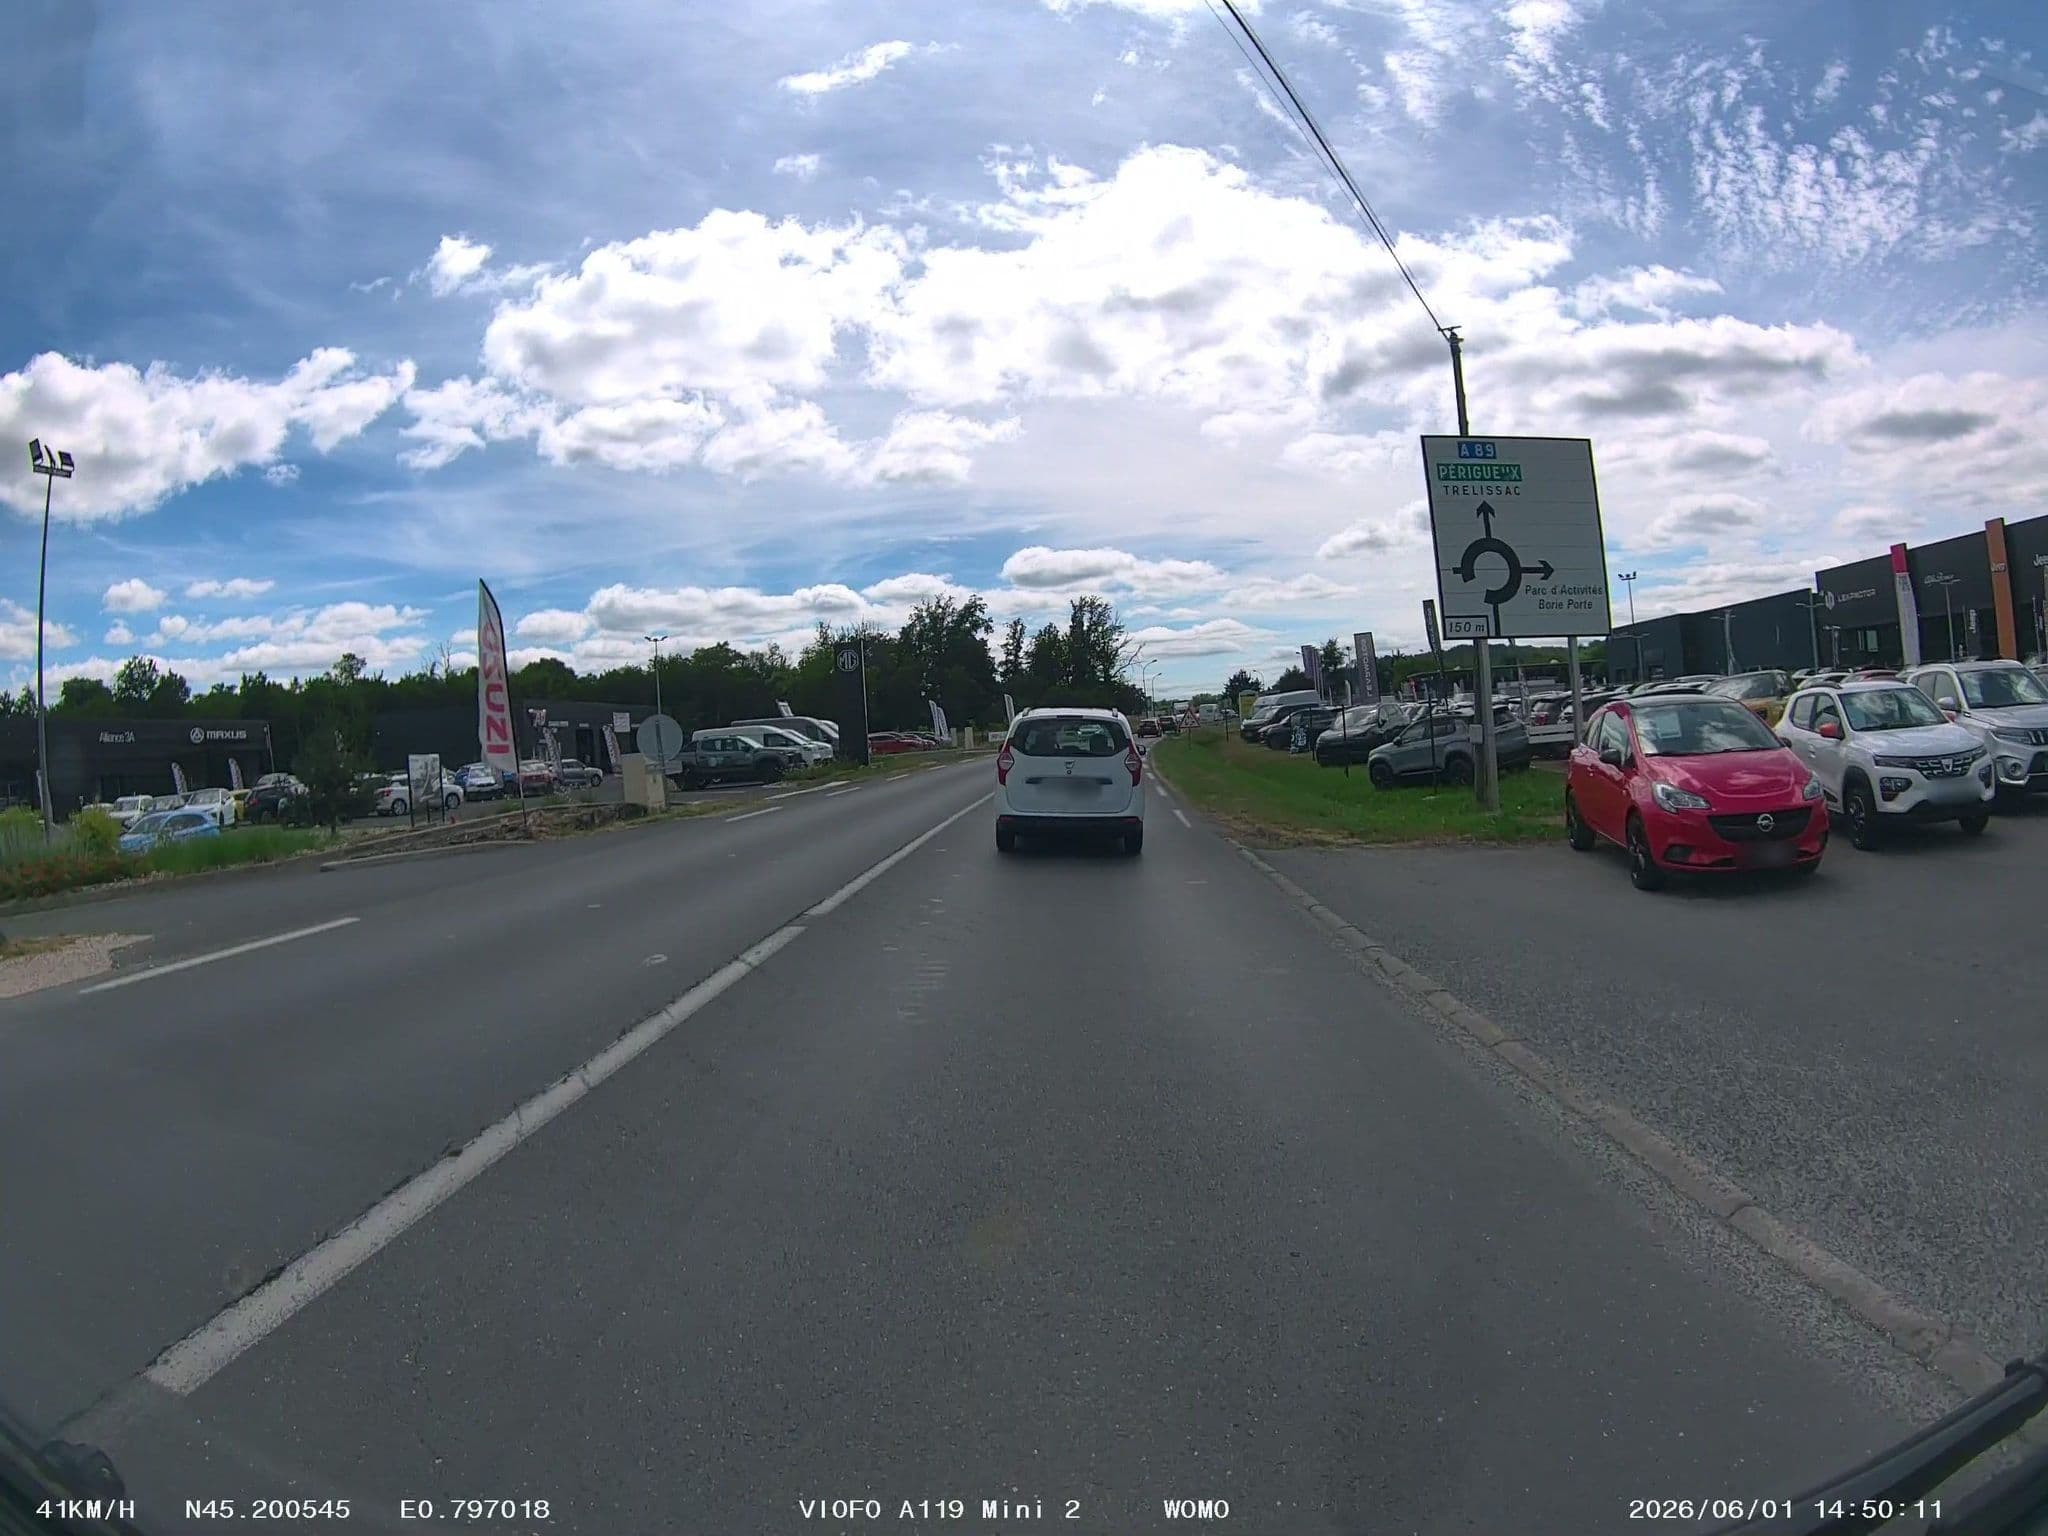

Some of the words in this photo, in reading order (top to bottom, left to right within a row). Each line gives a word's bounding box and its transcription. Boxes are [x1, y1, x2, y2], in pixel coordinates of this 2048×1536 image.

[1461, 444, 1470, 457] A
[1474, 444, 1494, 457] 89
[1442, 485, 1521, 496] TRELISSAC
[1525, 585, 1547, 595] Parc
[1538, 599, 1563, 610] Borie
[1567, 599, 1593, 610] Porte
[1448, 621, 1471, 633] 150
[1475, 624, 1485, 633] m
[838, 651, 858, 670] MG
[206, 730, 247, 740] MAXUS
